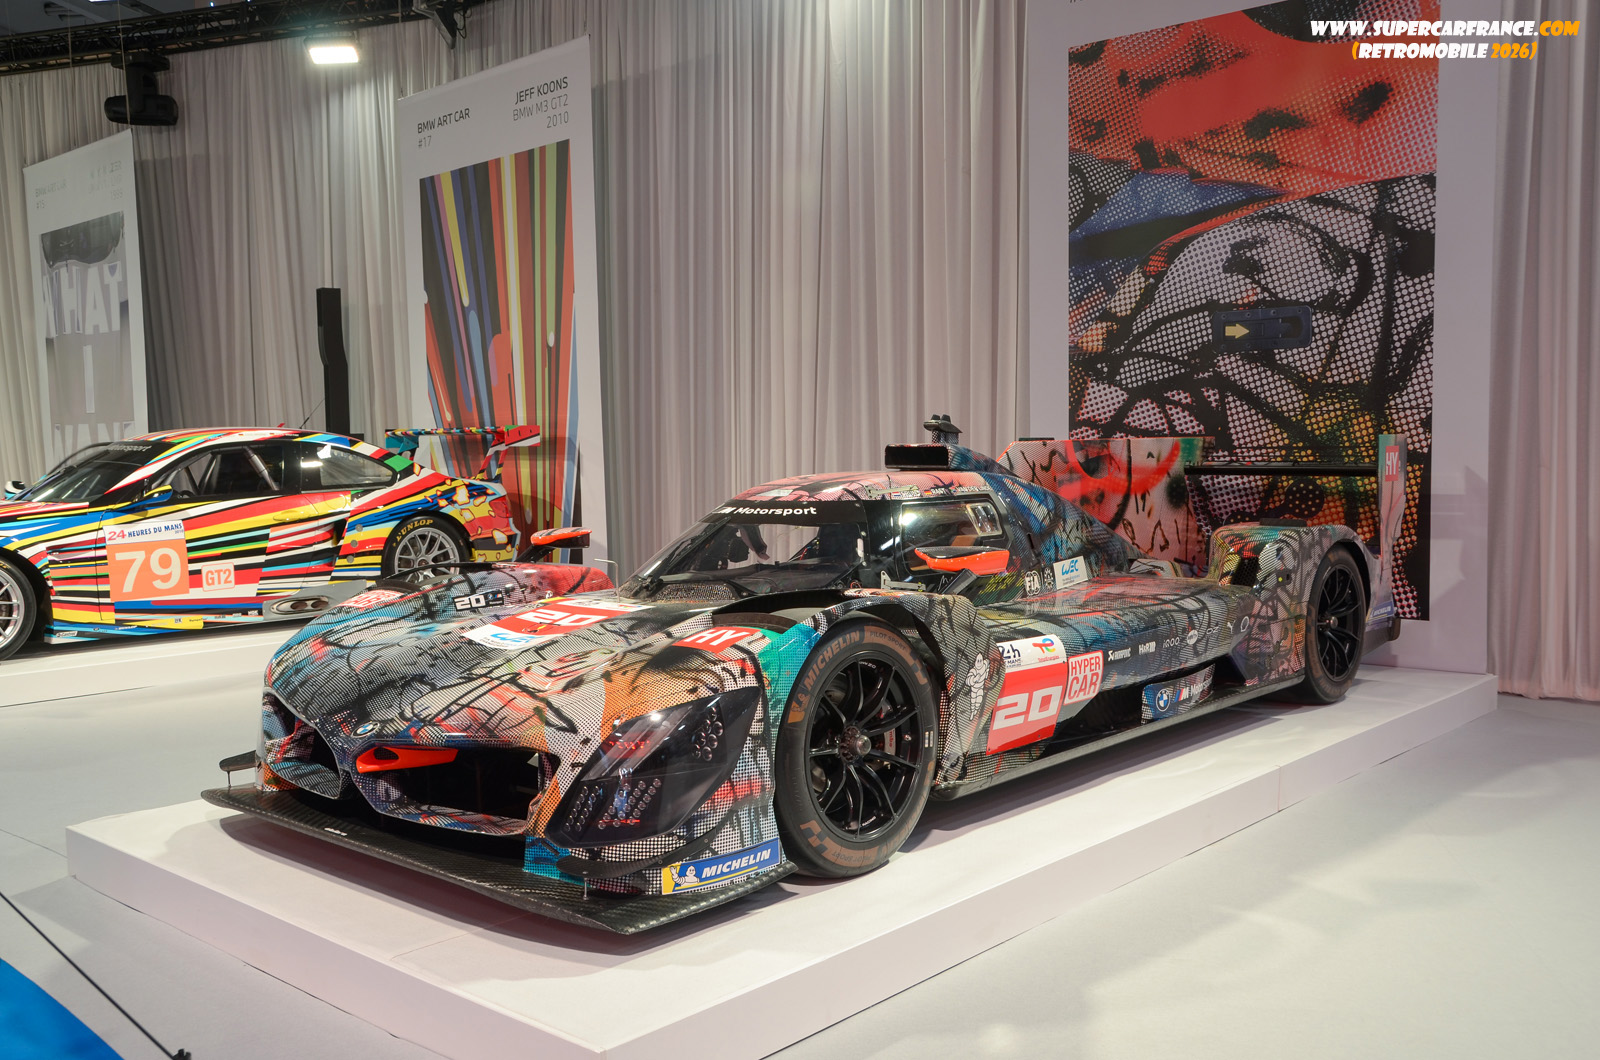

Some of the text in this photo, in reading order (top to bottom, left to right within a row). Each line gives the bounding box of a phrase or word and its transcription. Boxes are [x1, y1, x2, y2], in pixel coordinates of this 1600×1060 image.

[515, 76, 569, 105] JEFF KOONS
[512, 93, 569, 122] BMW M3 GT2
[417, 108, 471, 134] BMW ART CAR
[546, 110, 570, 129] 2010
[417, 135, 432, 149] #17
[1385, 451, 1399, 476] HY
[733, 507, 817, 516] Motorsport
[107, 523, 183, 541] 24 HEURES DU MANS
[396, 519, 434, 542] DUNLOP
[114, 547, 182, 594] 79
[204, 568, 233, 587] GT2
[1061, 559, 1079, 576] WEC
[453, 594, 486, 611] 20
[515, 609, 608, 626] 20
[684, 629, 751, 646] HY
[869, 631, 907, 651] PILOT SPORT
[803, 630, 860, 692] MICHELIN
[1070, 655, 1101, 677] HYPER
[1067, 672, 1100, 700] CAR
[992, 685, 1064, 731] 20
[701, 848, 772, 879] MICHELIN
